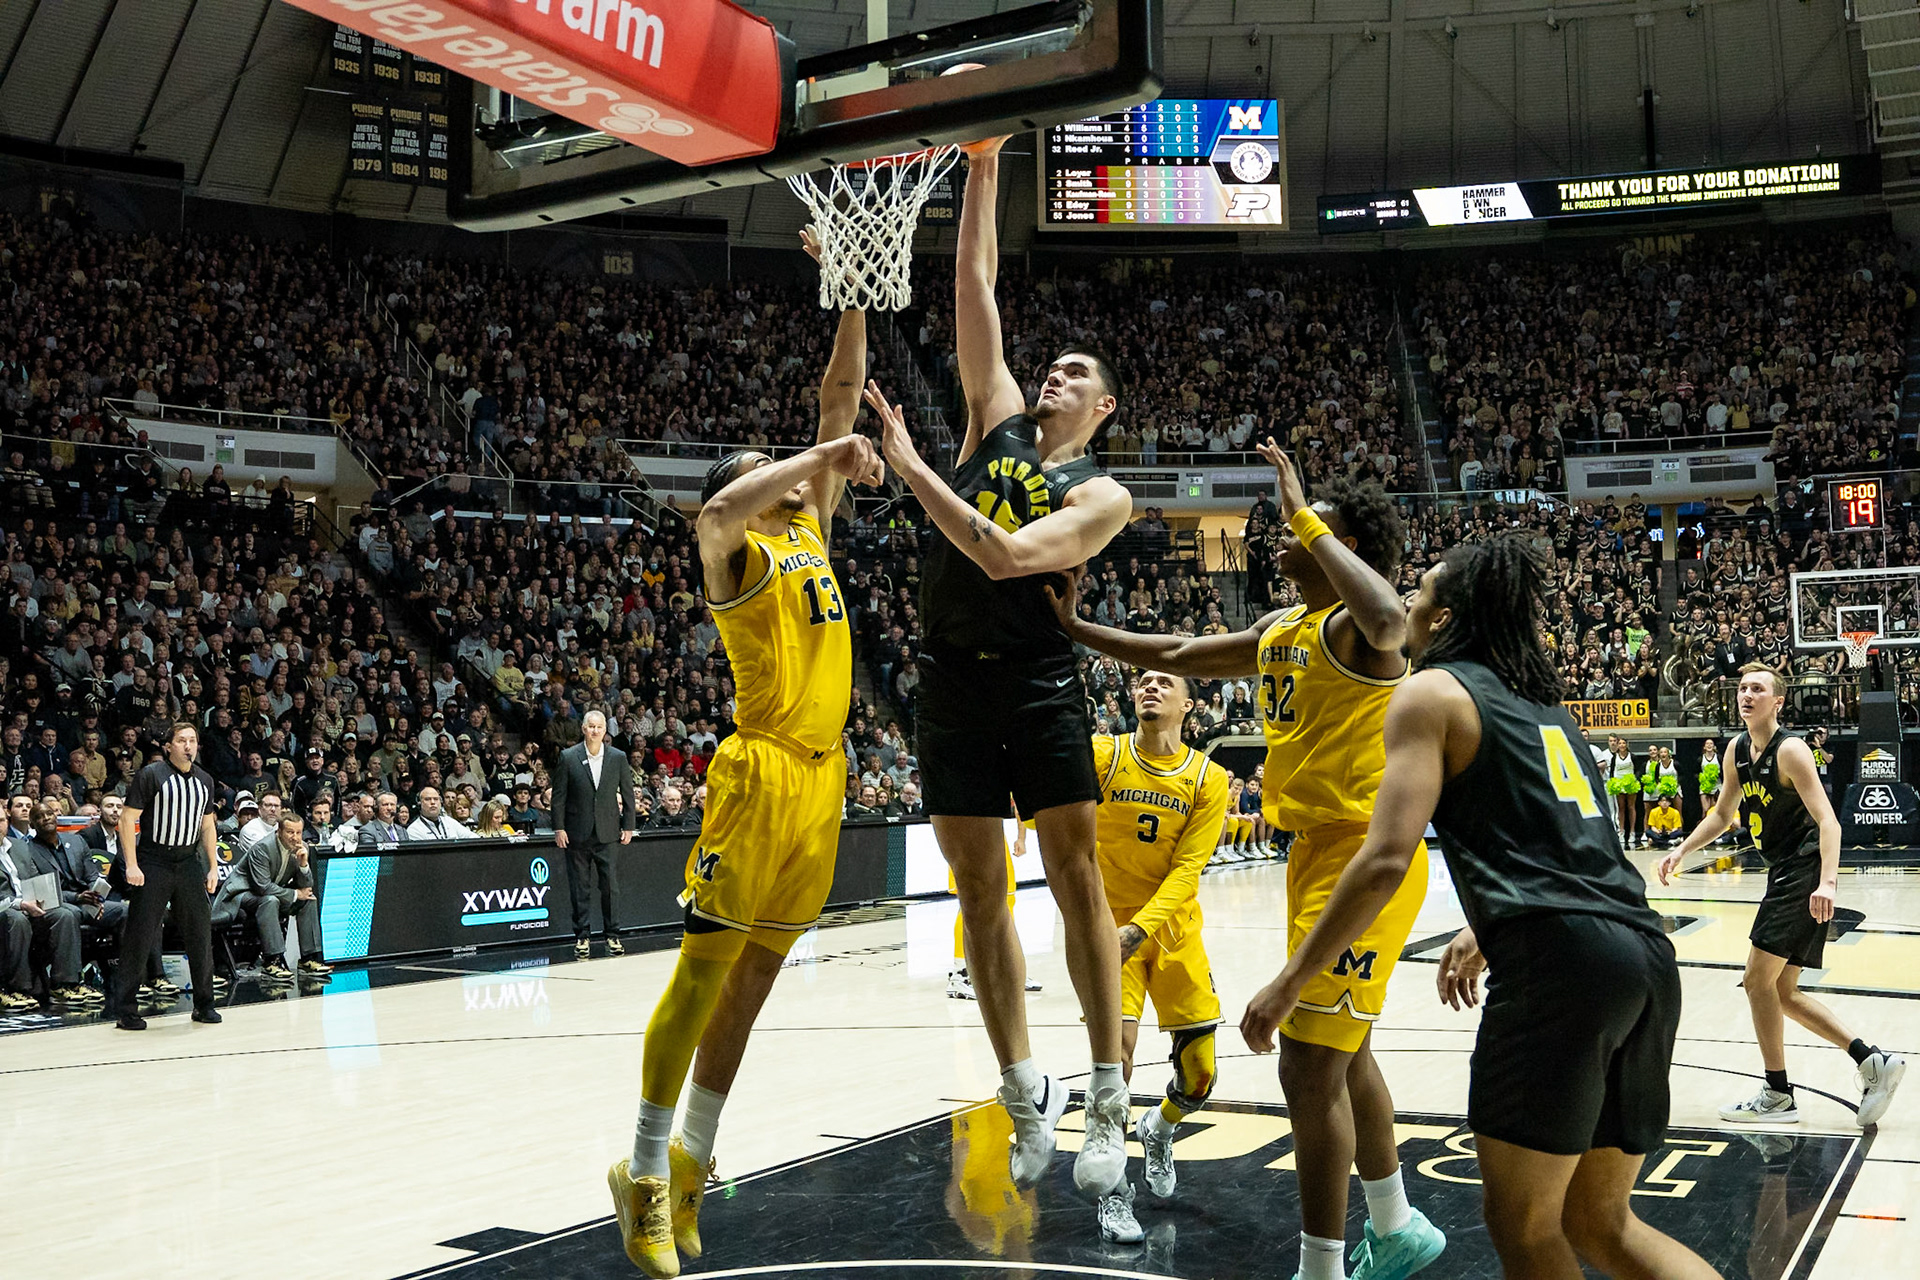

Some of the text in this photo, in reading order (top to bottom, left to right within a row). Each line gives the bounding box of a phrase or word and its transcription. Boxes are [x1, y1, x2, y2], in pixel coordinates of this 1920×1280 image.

[372, 46, 402, 60] CHAMPS
[334, 57, 360, 75] 1935
[373, 63, 400, 80] 1936
[414, 69, 442, 85] 1938
[352, 103, 384, 116] PURDUE
[390, 108, 422, 121] PURDUE
[1141, 113, 1147, 122] 1
[1193, 113, 1198, 122] 1
[1229, 106, 1262, 130] M
[355, 124, 379, 134] MEN'S
[394, 128, 417, 139] MEN'S
[353, 132, 381, 143] BIG TEN
[391, 136, 420, 148] BIG TEN
[351, 140, 382, 151] CHAMPS
[390, 145, 421, 157] CHAMPS
[352, 158, 382, 172] 1979
[1124, 157, 1131, 165] P
[1141, 157, 1148, 165] R
[1158, 157, 1166, 165] A
[1193, 157, 1199, 165] F
[391, 162, 419, 177] 1984
[1558, 162, 1840, 200] THANK YOU FOR YOUR DONATION!
[1462, 187, 1506, 199] HAMMER
[1561, 181, 1840, 211] ALL PROCEEDS GO TOWARDS THE PURDUE INSTITUTE FOR CANCER RESEARCH
[1225, 193, 1271, 217] P
[925, 207, 953, 219] 2023
[1838, 483, 1877, 500] 18:00
[1849, 499, 1875, 525] 19
[802, 576, 844, 626] 13
[1261, 673, 1297, 723] 32
[1592, 702, 1619, 715] LIVES
[1636, 702, 1646, 716] 6
[1592, 714, 1620, 727] HERE
[1538, 725, 1603, 819] 4
[1861, 761, 1896, 769] PURDUE
[1110, 789, 1192, 818] MICHIGAN
[1137, 813, 1160, 844] 3
[1749, 812, 1763, 850] 2
[694, 847, 722, 882] M
[462, 886, 548, 913] XYWAY
[510, 920, 550, 931] FUNGICIDES
[1332, 945, 1379, 981] M
